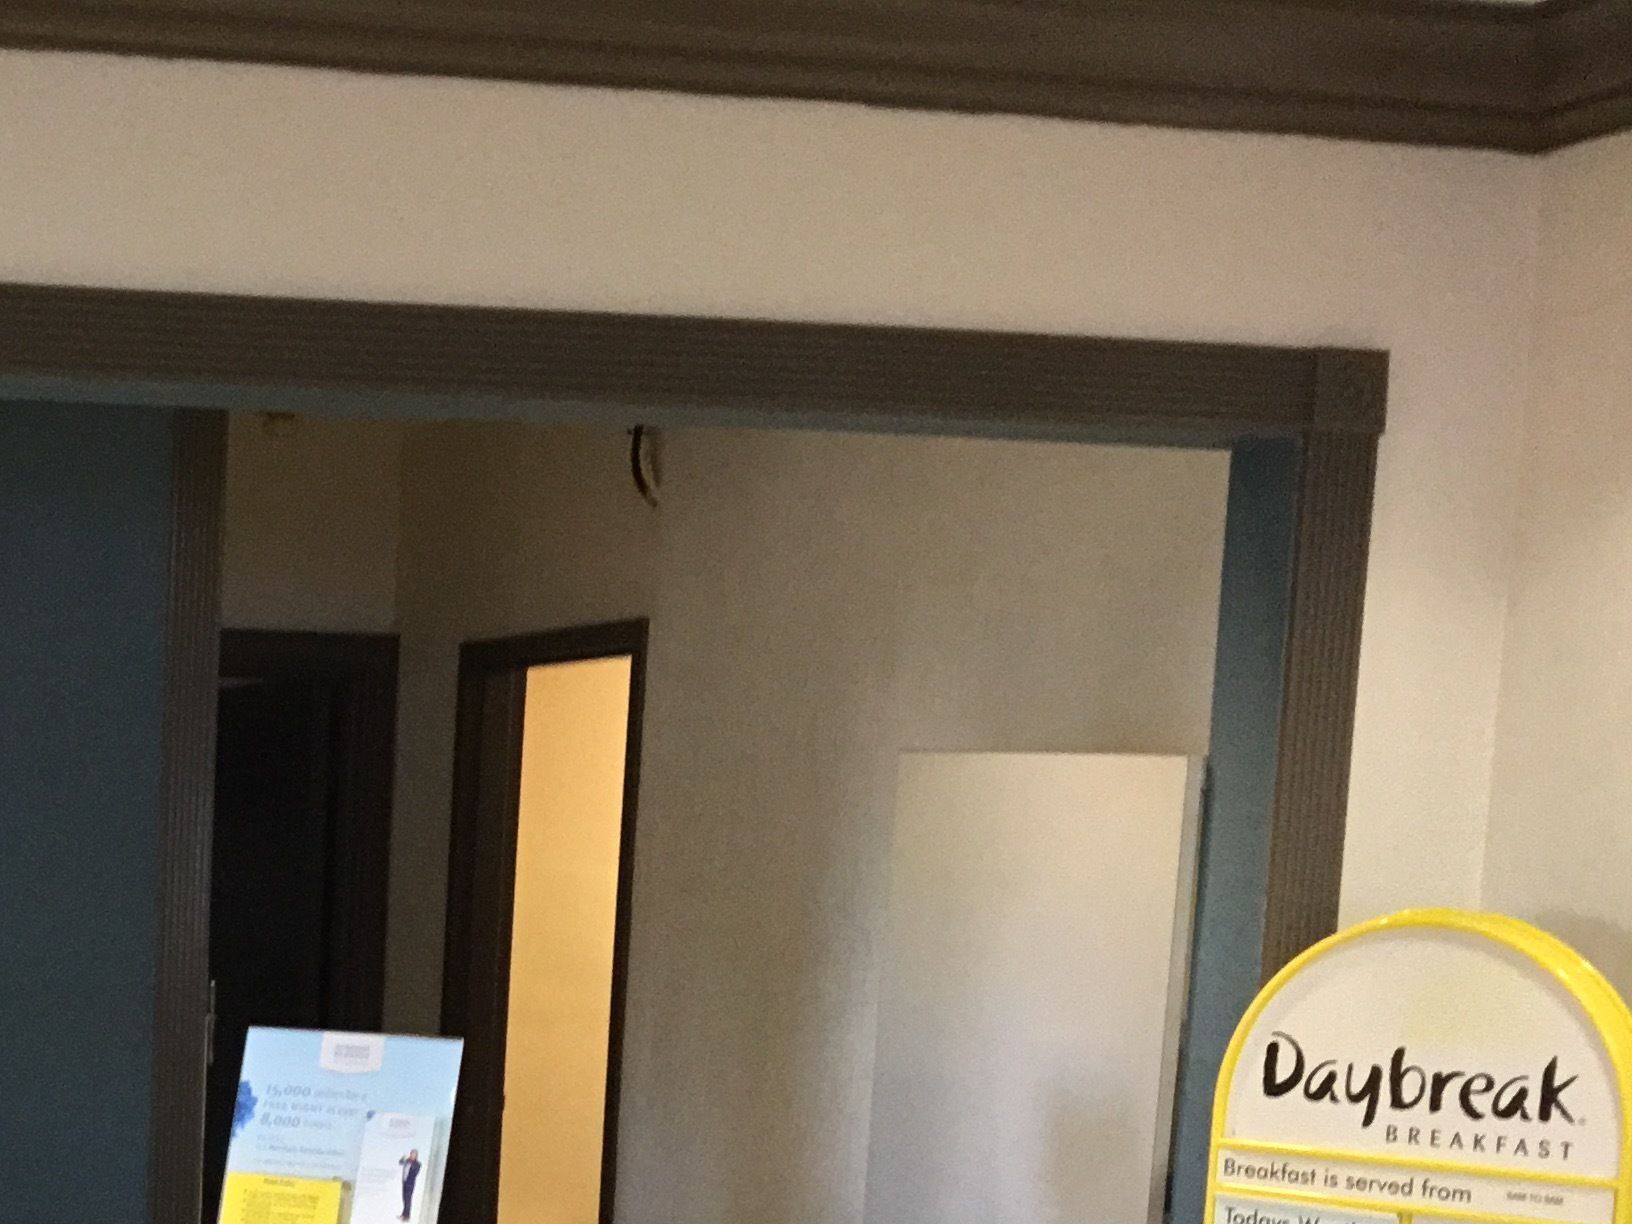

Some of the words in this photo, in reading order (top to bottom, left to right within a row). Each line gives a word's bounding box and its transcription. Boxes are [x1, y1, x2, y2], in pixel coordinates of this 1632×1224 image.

[1262, 1030, 1579, 1128] Daybreak
[1385, 1125, 1574, 1161] BREAKFAST
[1223, 1158, 1316, 1188] Breakfast
[1324, 1167, 1338, 1188] is
[1345, 1171, 1413, 1199] served
[1422, 1174, 1472, 1203] from
